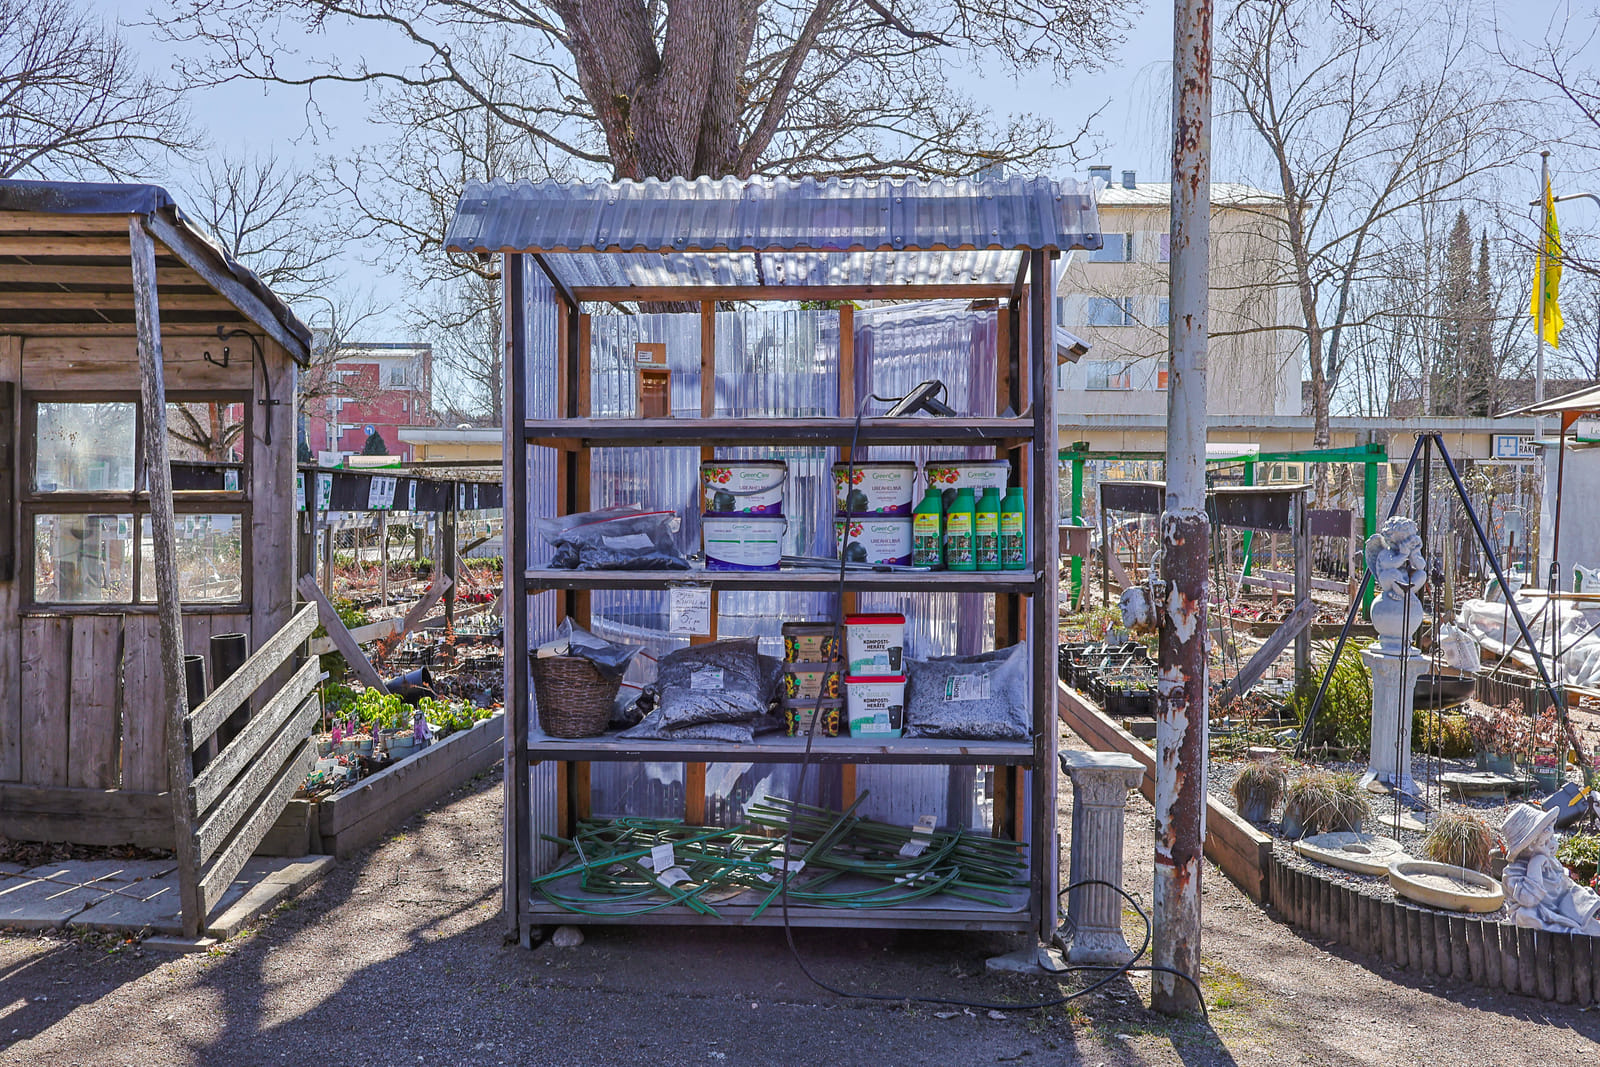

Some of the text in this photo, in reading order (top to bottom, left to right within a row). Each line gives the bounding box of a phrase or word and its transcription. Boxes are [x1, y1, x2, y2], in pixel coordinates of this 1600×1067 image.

[1519, 436, 1534, 444] KYM
[872, 472, 901, 480] GreenCare
[871, 525, 900, 533] GreenCare
